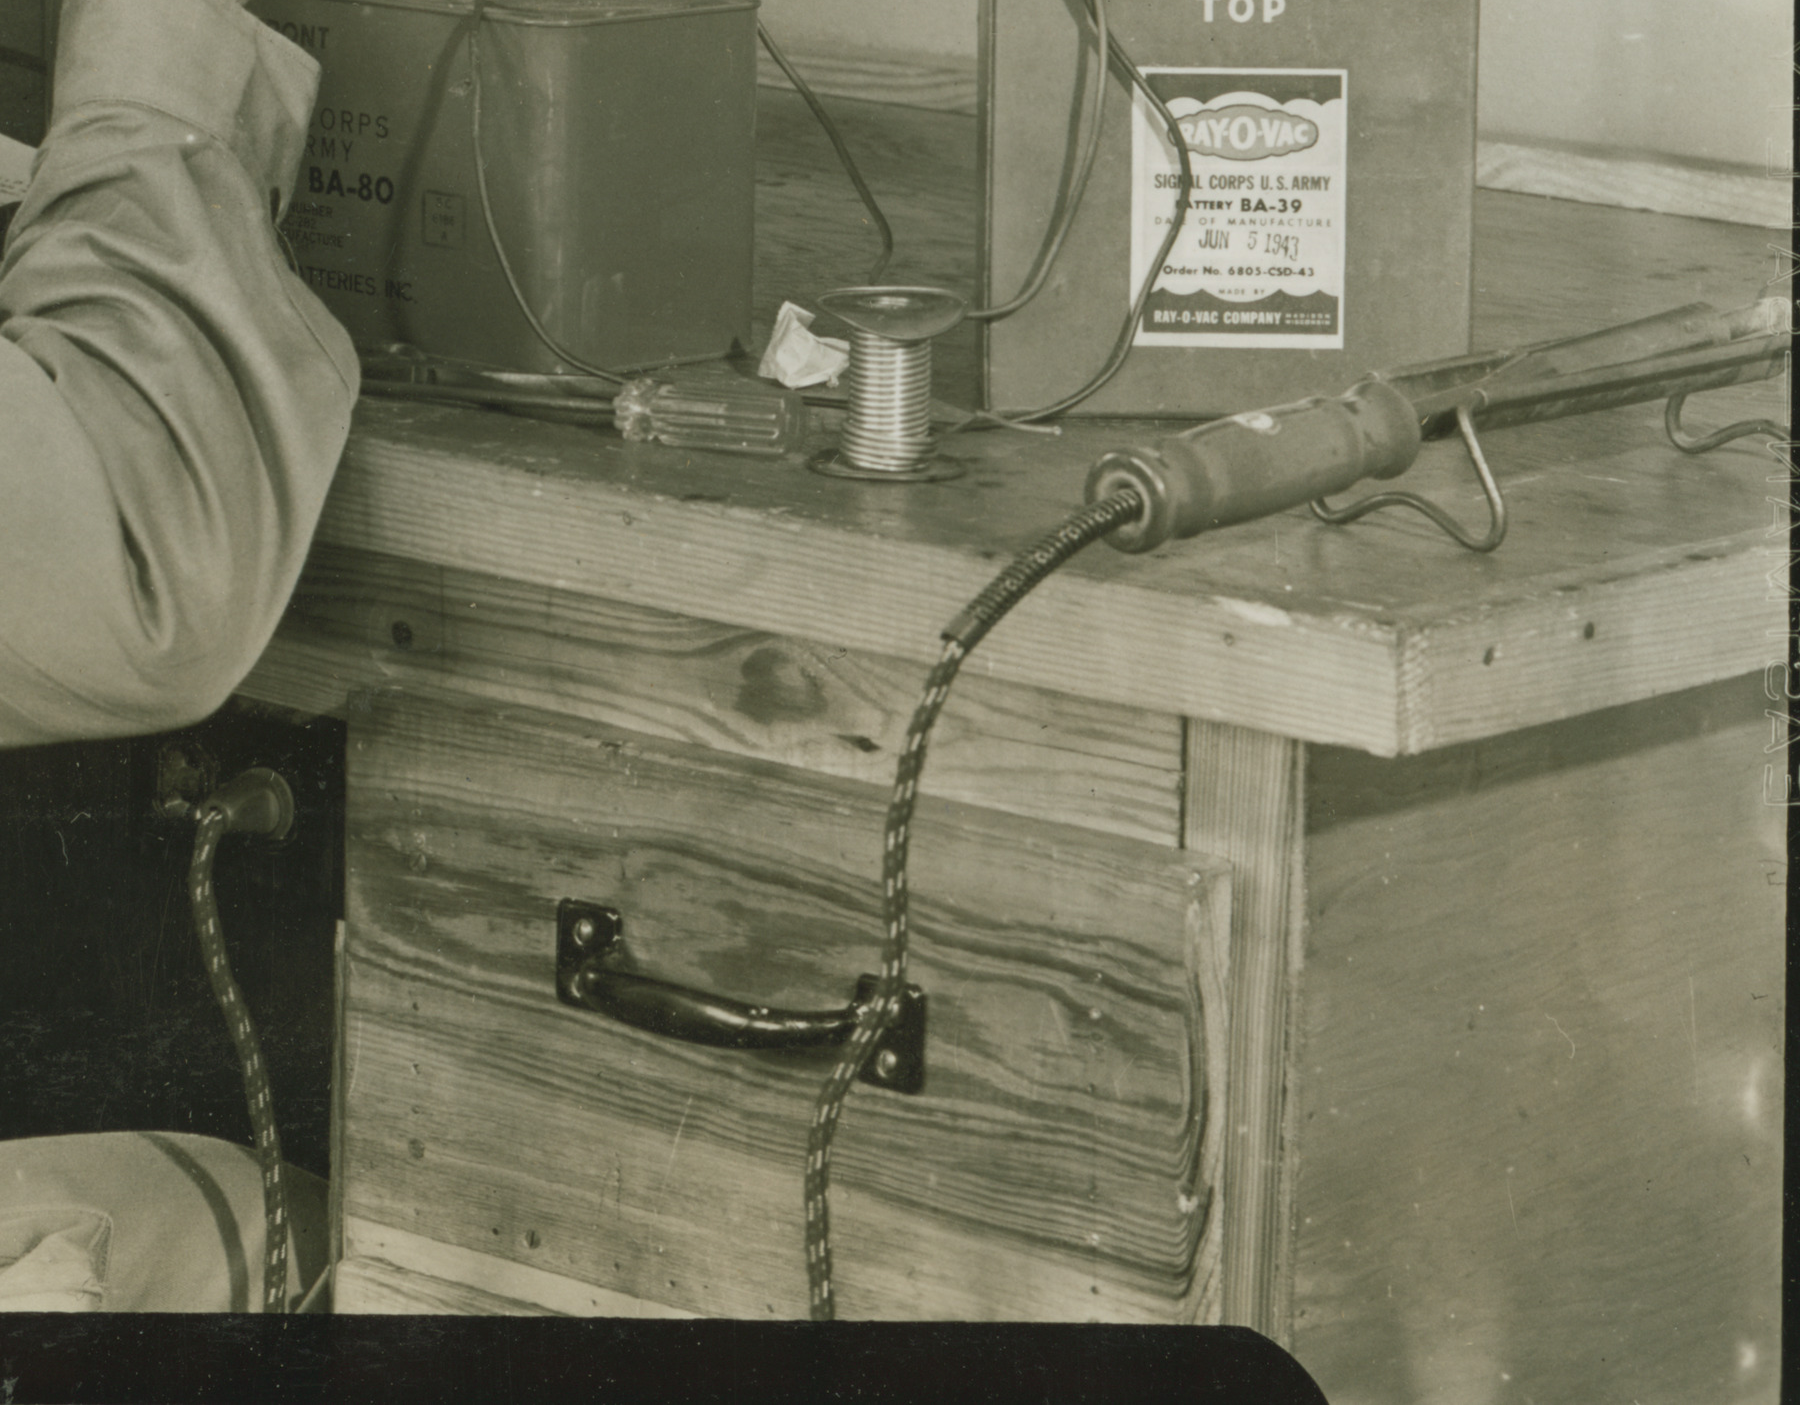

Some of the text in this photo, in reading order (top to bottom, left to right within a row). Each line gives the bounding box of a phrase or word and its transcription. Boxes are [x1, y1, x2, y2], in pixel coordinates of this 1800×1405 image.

[309, 107, 389, 139] ORPS
[304, 134, 354, 162] RMY
[309, 166, 395, 204] BA-80
[1209, 174, 1254, 190] CORPS
[1291, 176, 1331, 191] ARMY
[1240, 198, 1302, 213] BA-39
[1199, 217, 1216, 226] OF
[1227, 218, 1332, 227] MANUFACTURE
[1198, 229, 1299, 261] JUN 5 1943
[1162, 265, 1315, 277] Order No. 6805-CSD-43
[385, 278, 418, 304] INC.
[1154, 310, 1282, 325] RAY-O-VAC COMPANY
